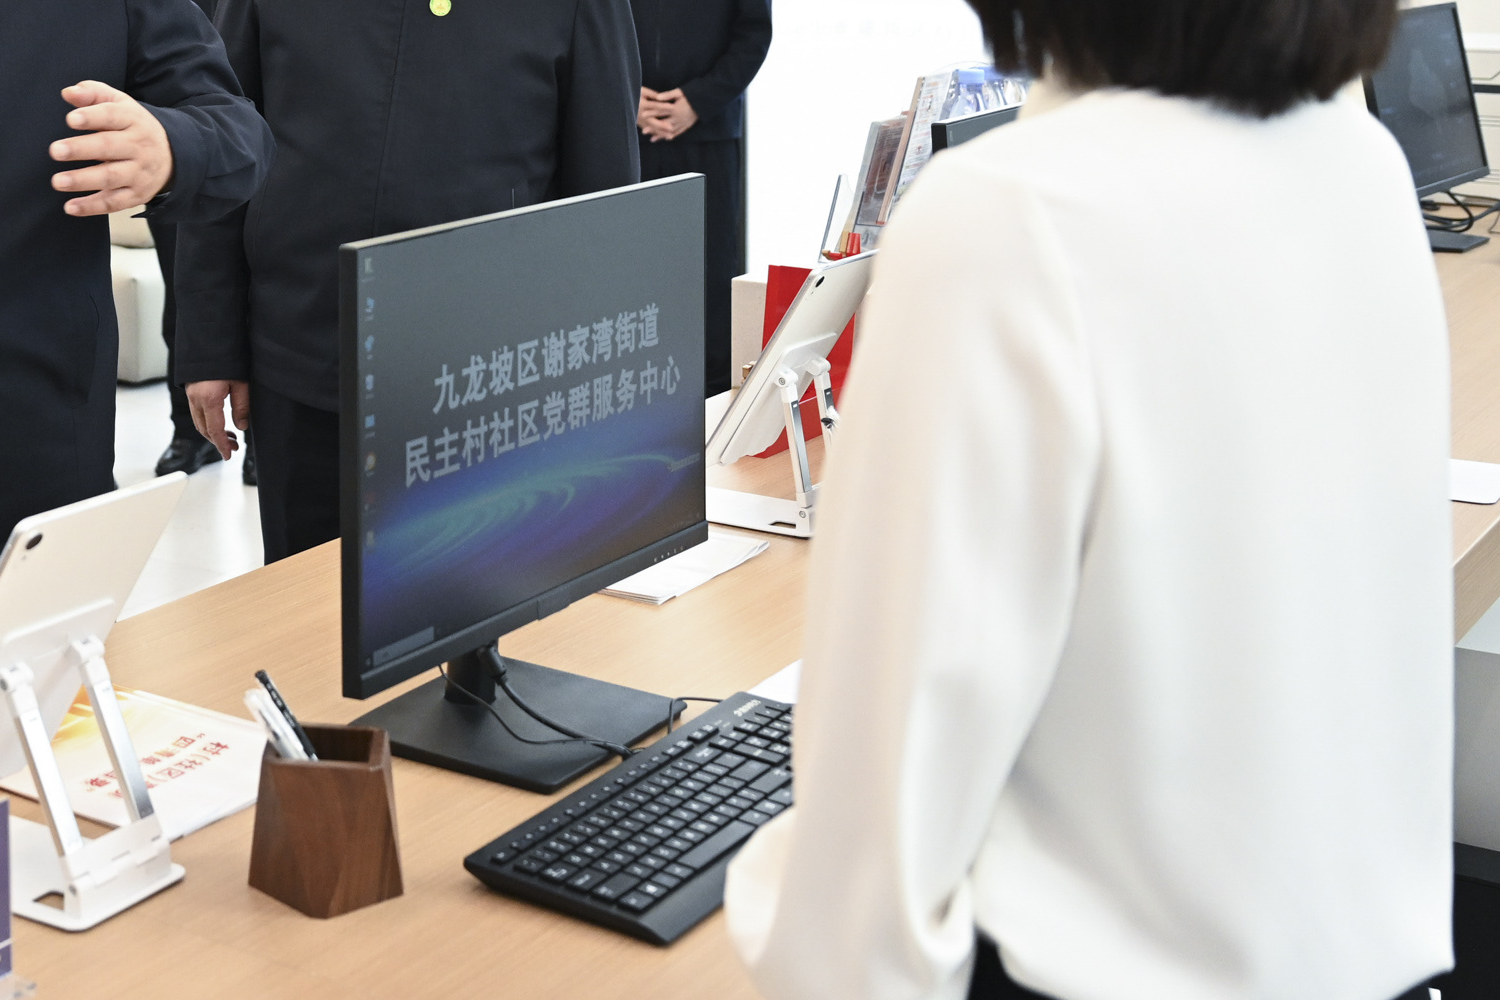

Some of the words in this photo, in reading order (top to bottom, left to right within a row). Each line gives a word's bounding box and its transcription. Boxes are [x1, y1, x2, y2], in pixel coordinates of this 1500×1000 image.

[433, 302, 660, 415] 九龙坡区谢家湾街道
[405, 354, 681, 489] 民主村社区党群服务中心
